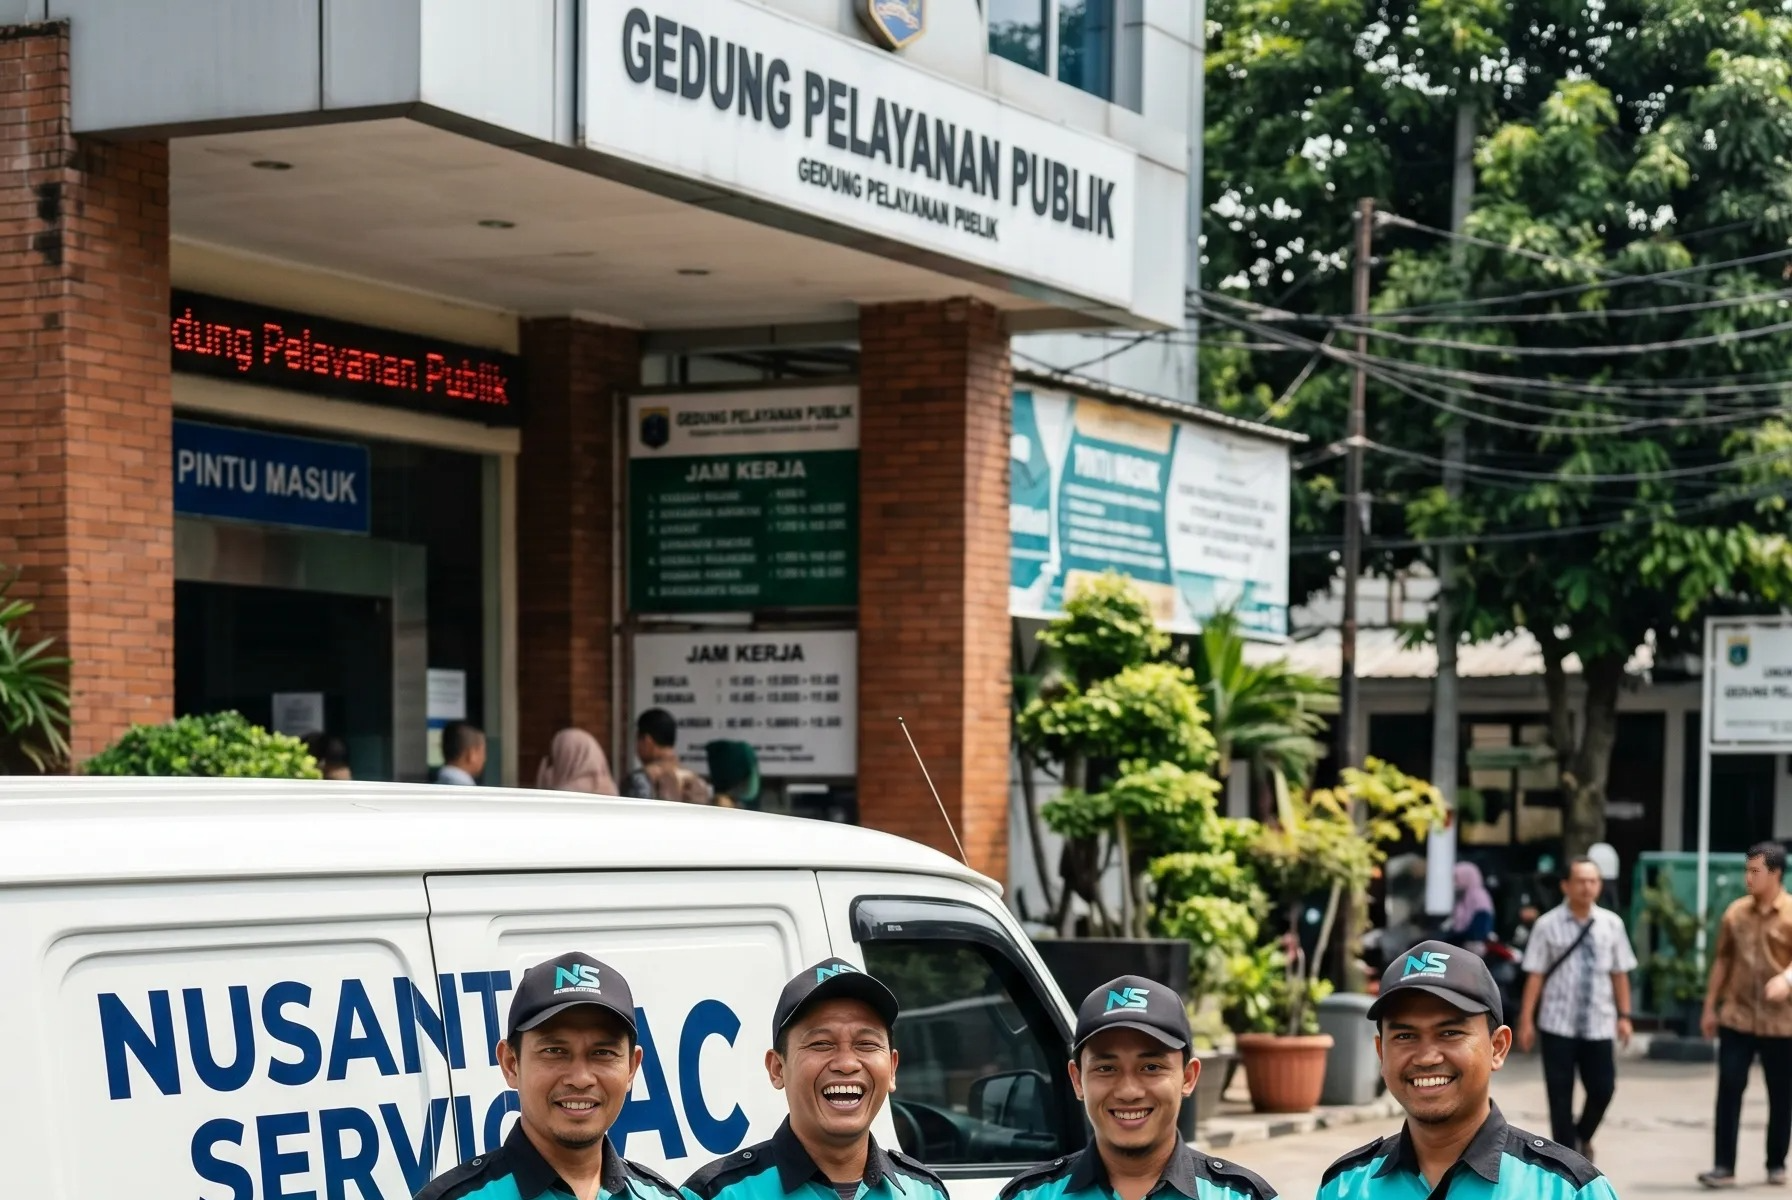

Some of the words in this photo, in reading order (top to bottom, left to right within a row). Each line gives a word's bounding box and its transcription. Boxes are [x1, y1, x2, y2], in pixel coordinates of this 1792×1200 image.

[623, 8, 791, 129] GEDUNG
[804, 70, 1000, 200] PELAYANAN
[1012, 145, 1115, 239] PUBLIK
[798, 157, 862, 198] GEDUNG
[178, 450, 257, 493] PINTU
[266, 461, 357, 504] MASUK
[685, 462, 729, 482] JAM
[736, 459, 806, 480] KERJA
[686, 645, 730, 663] JAM
[735, 643, 804, 662] KERJA
[555, 963, 600, 989] NS
[1403, 951, 1450, 976] NS
[1106, 987, 1150, 1011] NS
[606, 999, 750, 1160] AC
